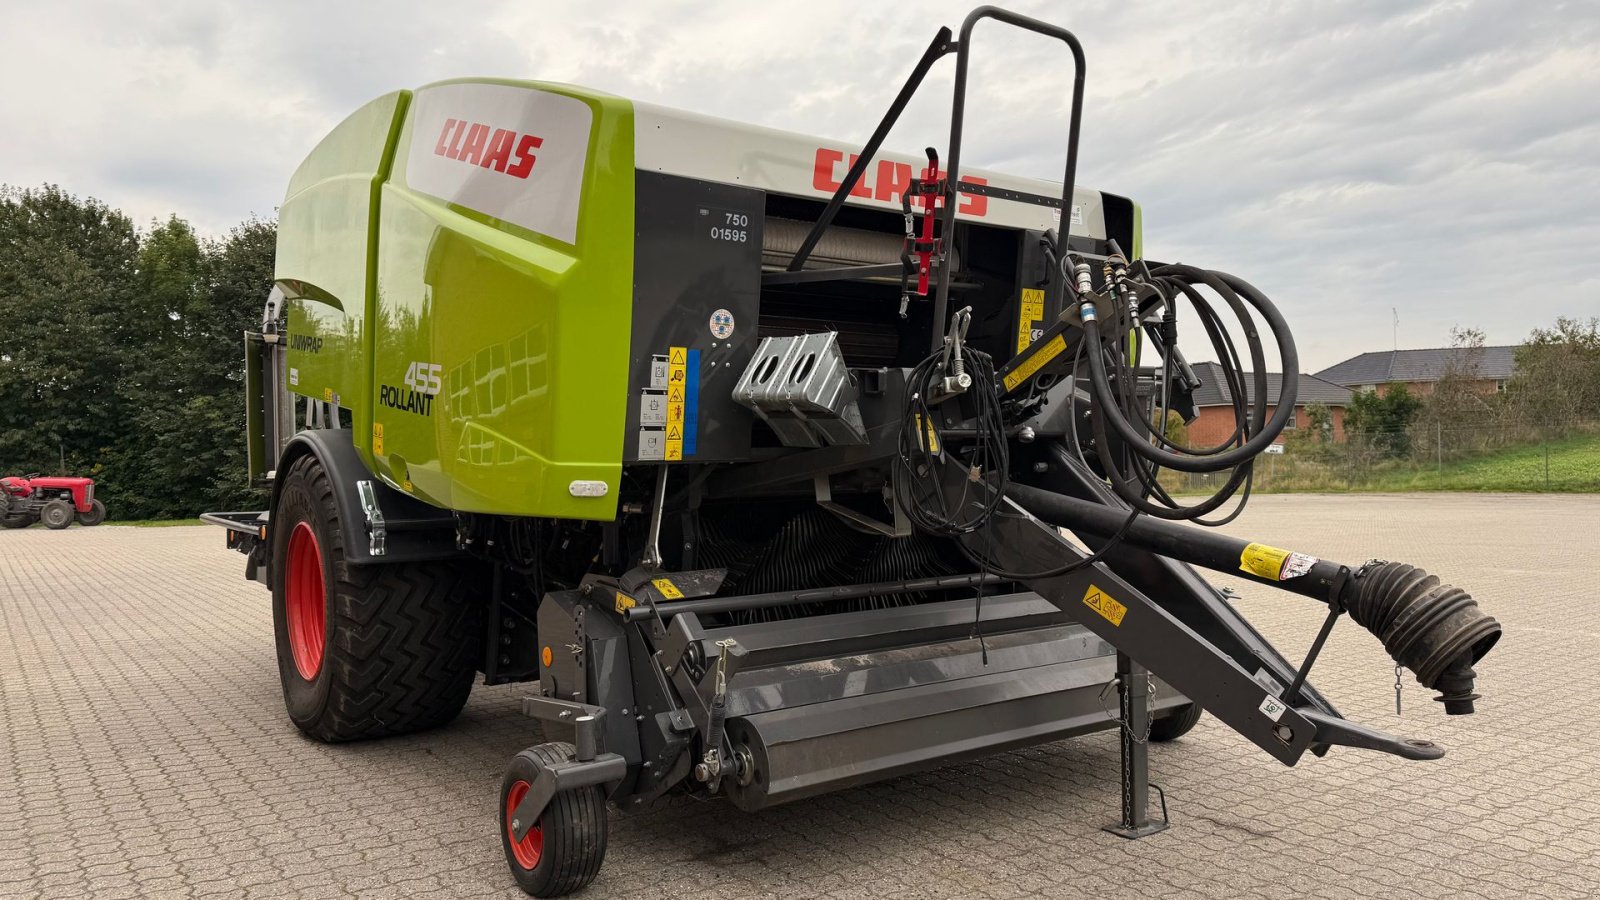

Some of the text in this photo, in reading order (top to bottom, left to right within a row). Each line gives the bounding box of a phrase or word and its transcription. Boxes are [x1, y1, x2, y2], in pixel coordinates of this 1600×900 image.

[434, 118, 544, 179] CLAAS
[813, 148, 988, 217] CLAS
[710, 226, 747, 243] 01595
[725, 212, 748, 227] 750
[404, 361, 442, 395] 455
[380, 384, 434, 416] ROLLANT
